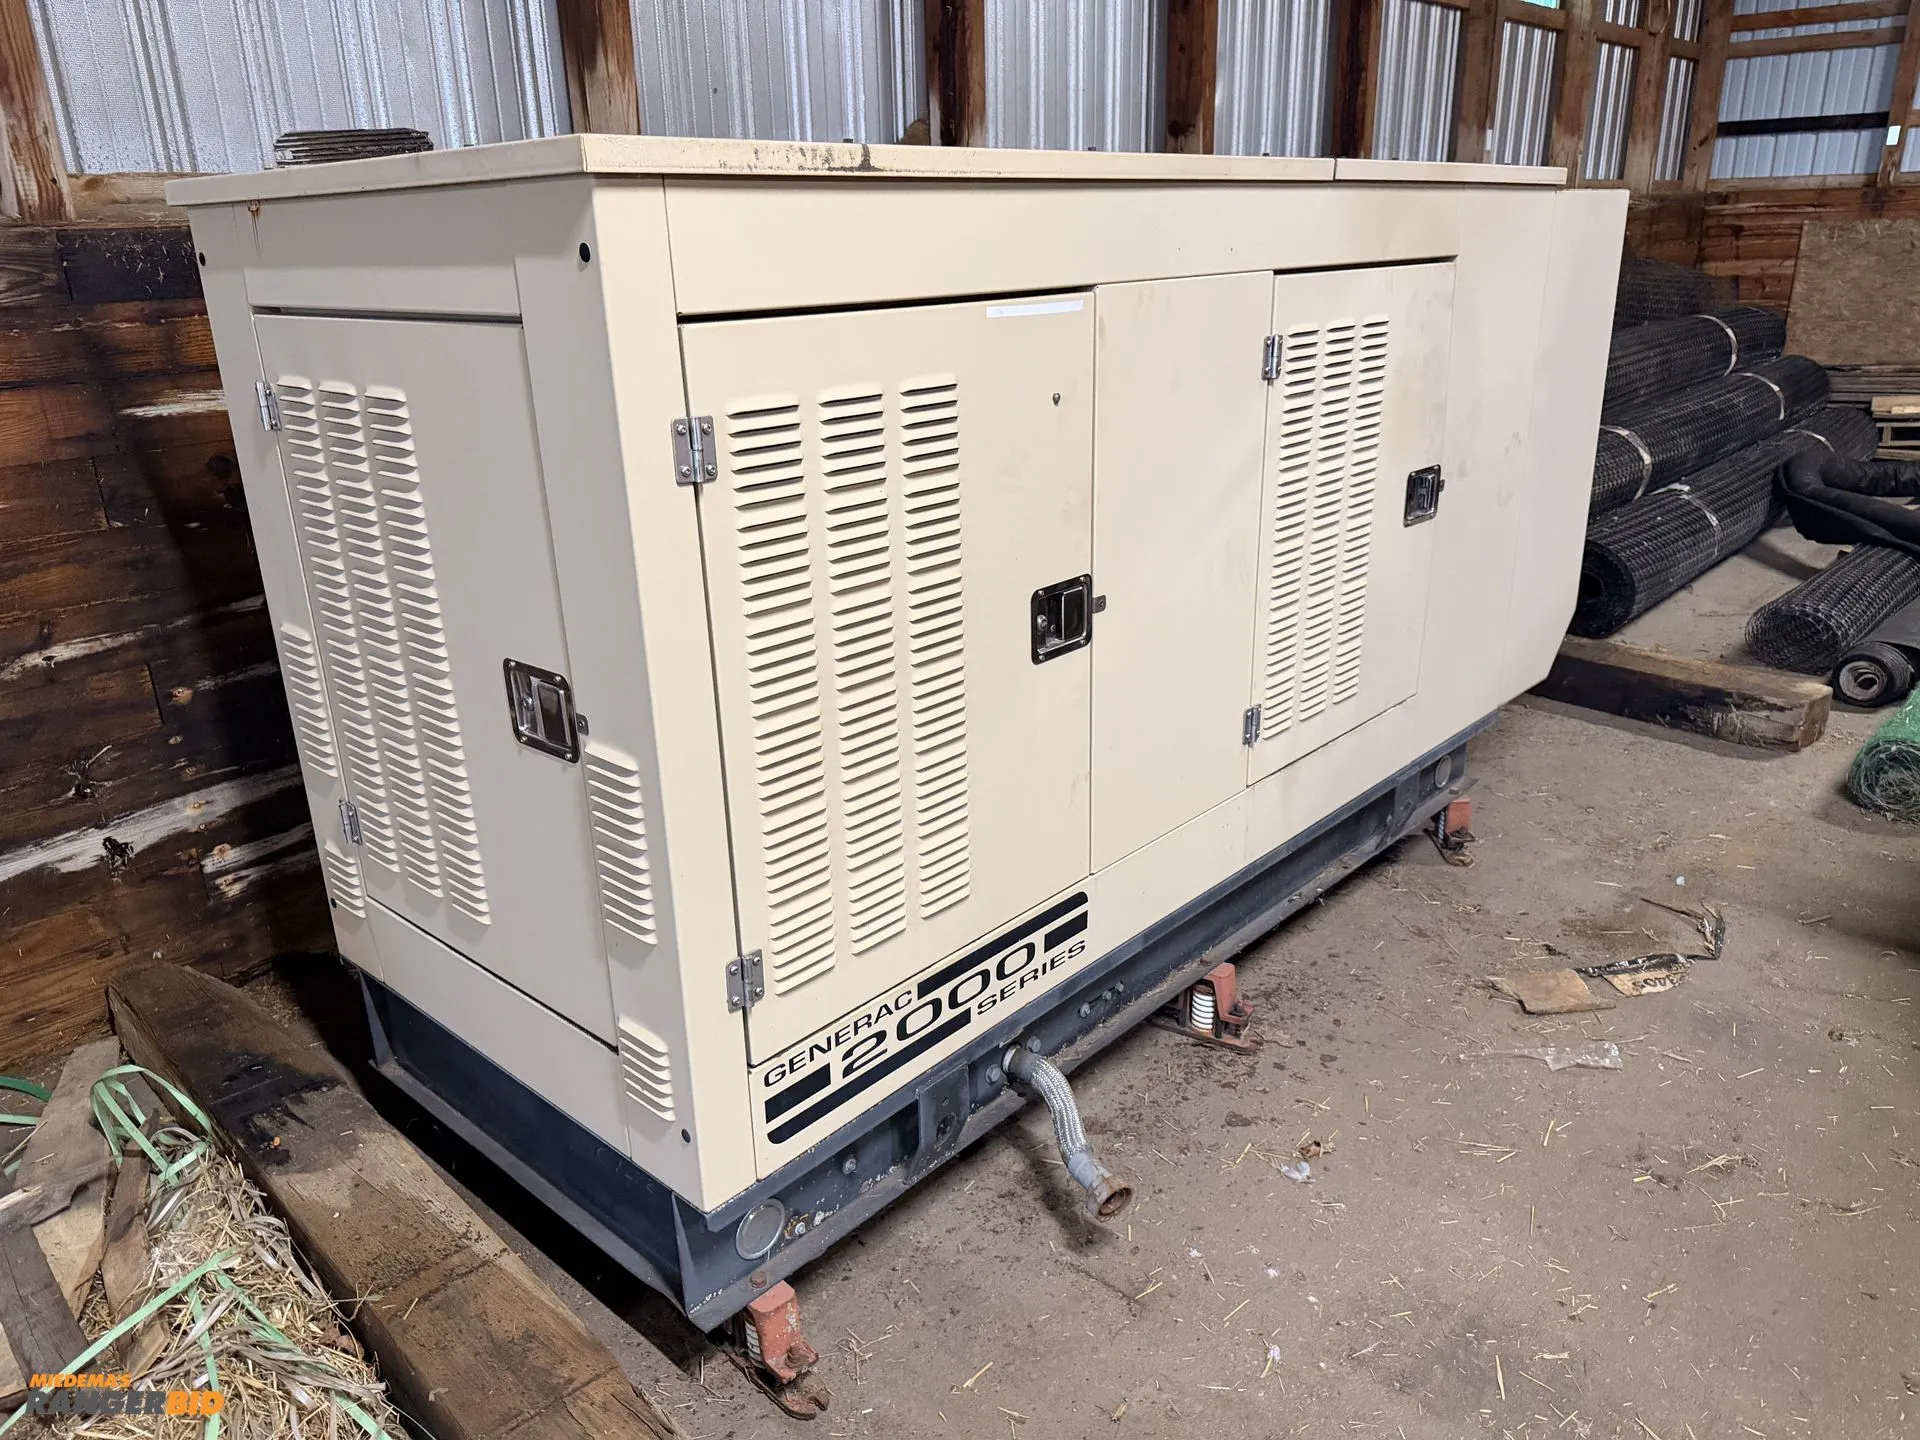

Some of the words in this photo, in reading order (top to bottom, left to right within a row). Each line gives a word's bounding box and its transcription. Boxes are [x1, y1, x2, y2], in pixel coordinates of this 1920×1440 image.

[842, 941, 1036, 1078] 2000
[977, 940, 1086, 1015] SERIES
[763, 990, 912, 1088] GENERAC
